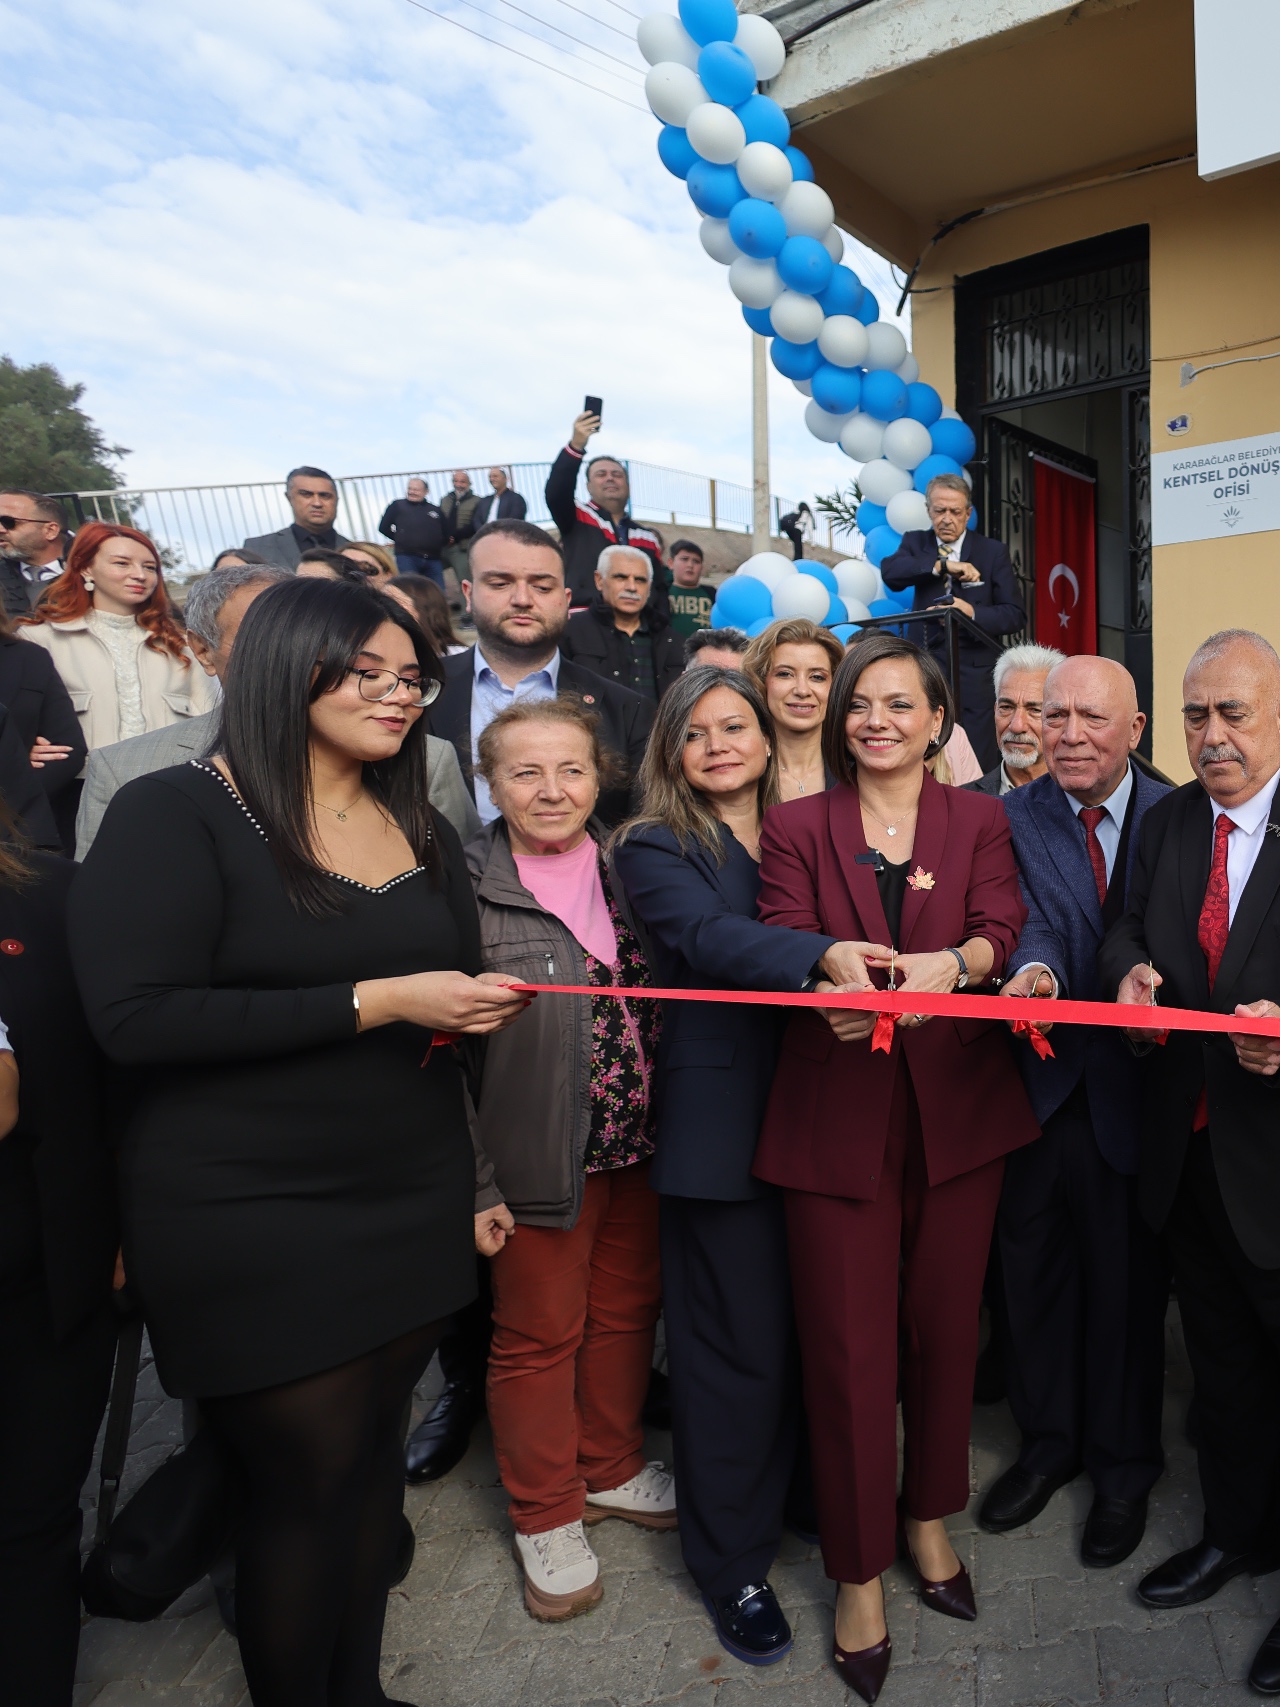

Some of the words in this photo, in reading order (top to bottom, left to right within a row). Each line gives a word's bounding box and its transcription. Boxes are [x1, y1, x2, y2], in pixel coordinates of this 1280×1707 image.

[1172, 453, 1236, 472] KARABAĞLAR
[1163, 469, 1224, 489] KENTSEL
[1213, 480, 1250, 499] OFİSİ
